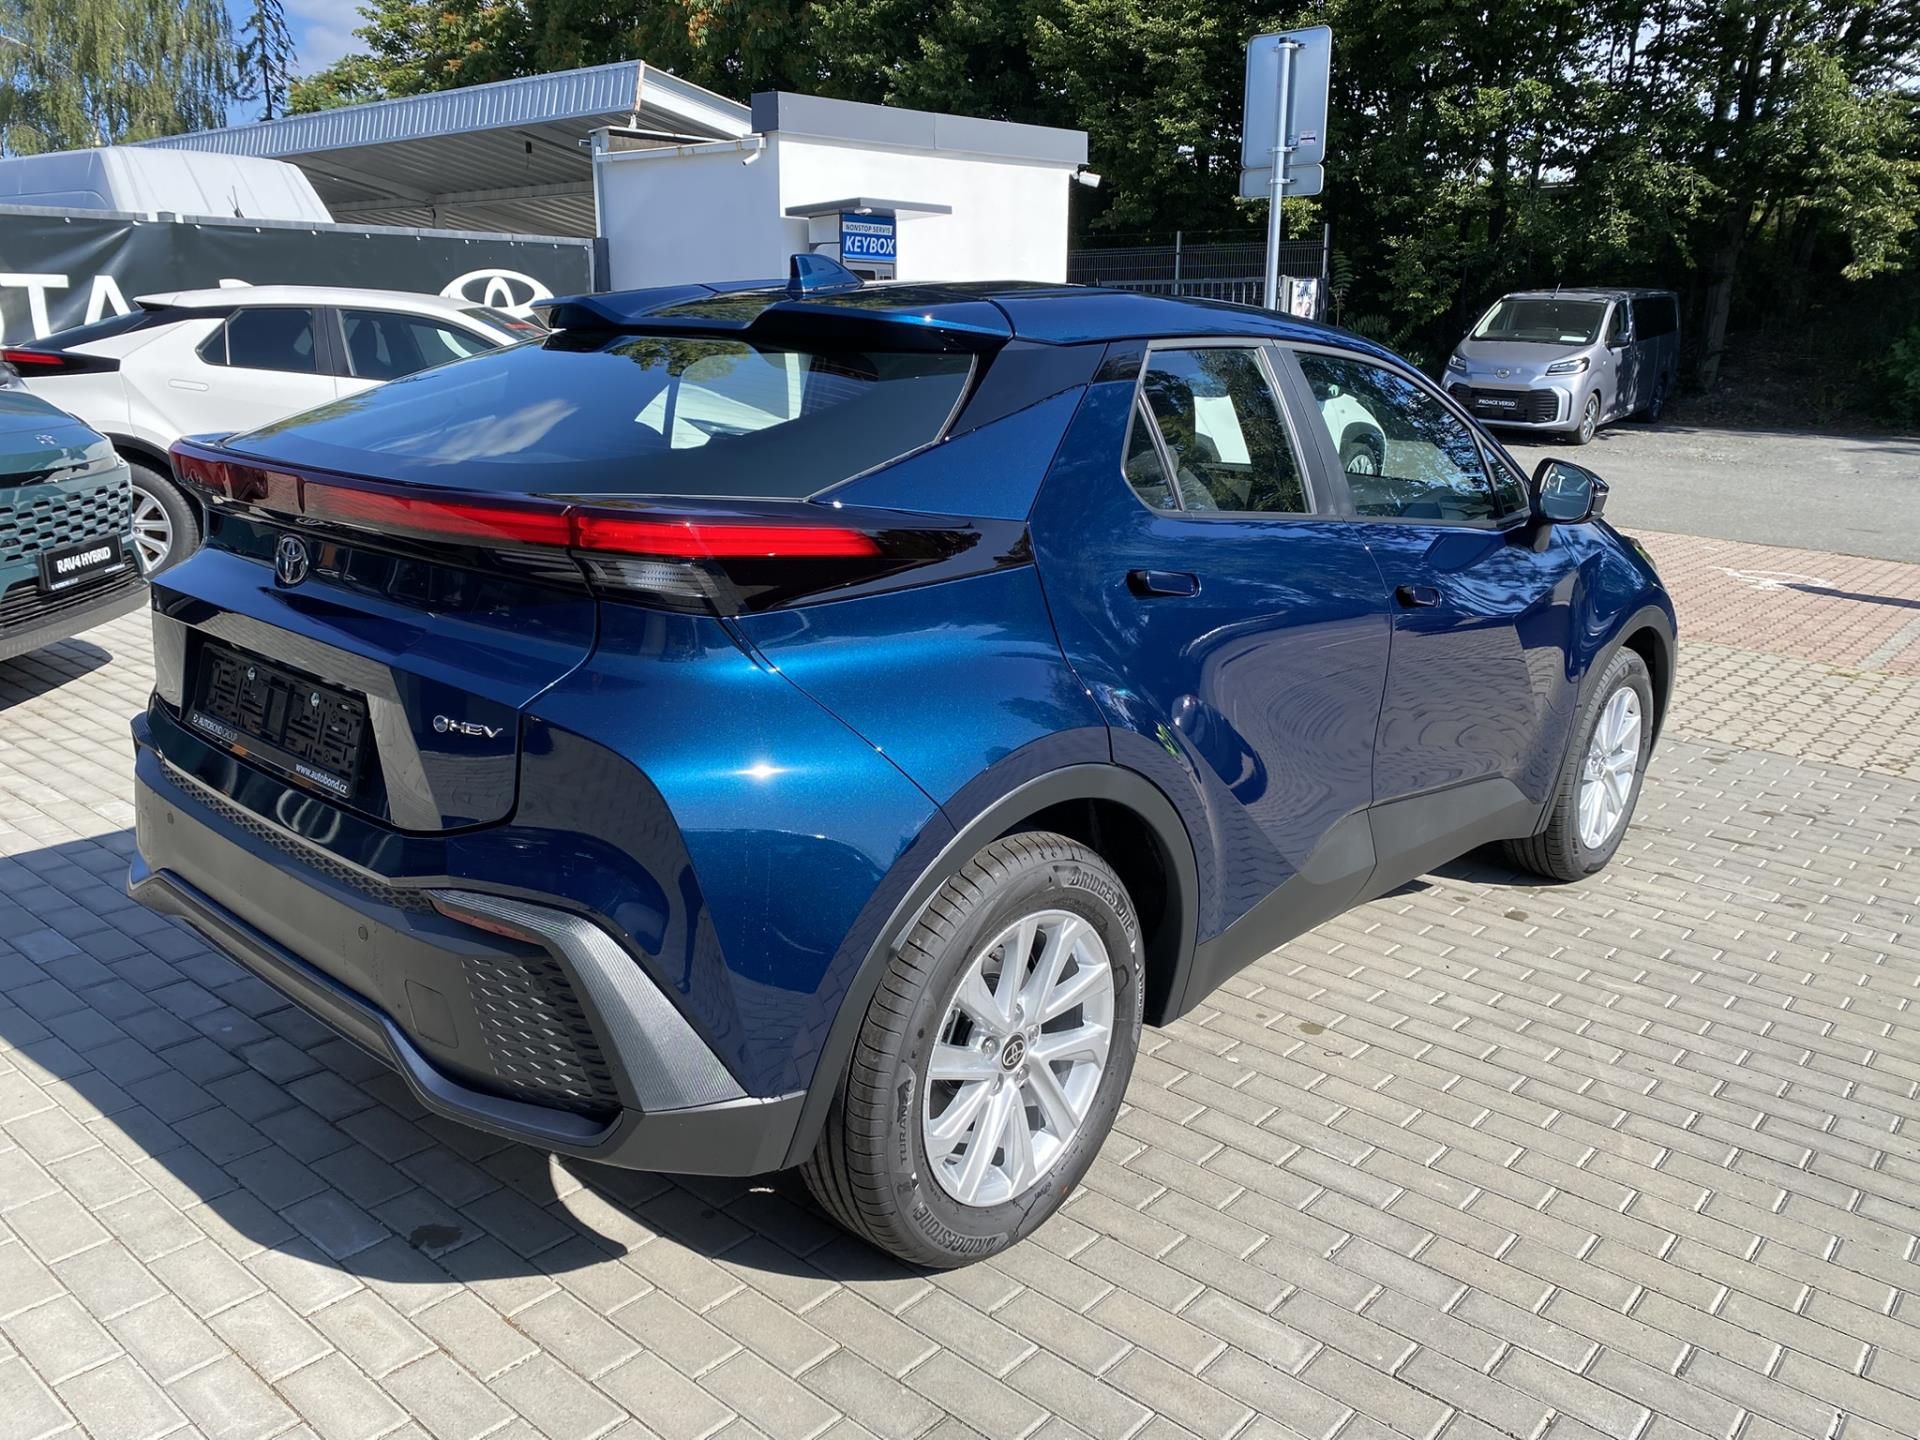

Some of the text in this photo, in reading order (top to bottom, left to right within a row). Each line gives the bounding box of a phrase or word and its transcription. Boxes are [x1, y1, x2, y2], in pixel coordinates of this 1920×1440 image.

[845, 223, 891, 234] NONSTOP SERVIS
[845, 235, 895, 254] KEYBOX
[56, 553, 82, 574] RAV4
[80, 546, 112, 567] HYBRID
[198, 717, 223, 735] AUTOBOND
[449, 719, 504, 738] HEV
[295, 763, 348, 794] www.autobond.cz
[1069, 867, 1136, 933] BRIDGESTONE
[897, 1078, 915, 1166] TURANZA
[912, 1204, 998, 1255] BRIDGESTONE
